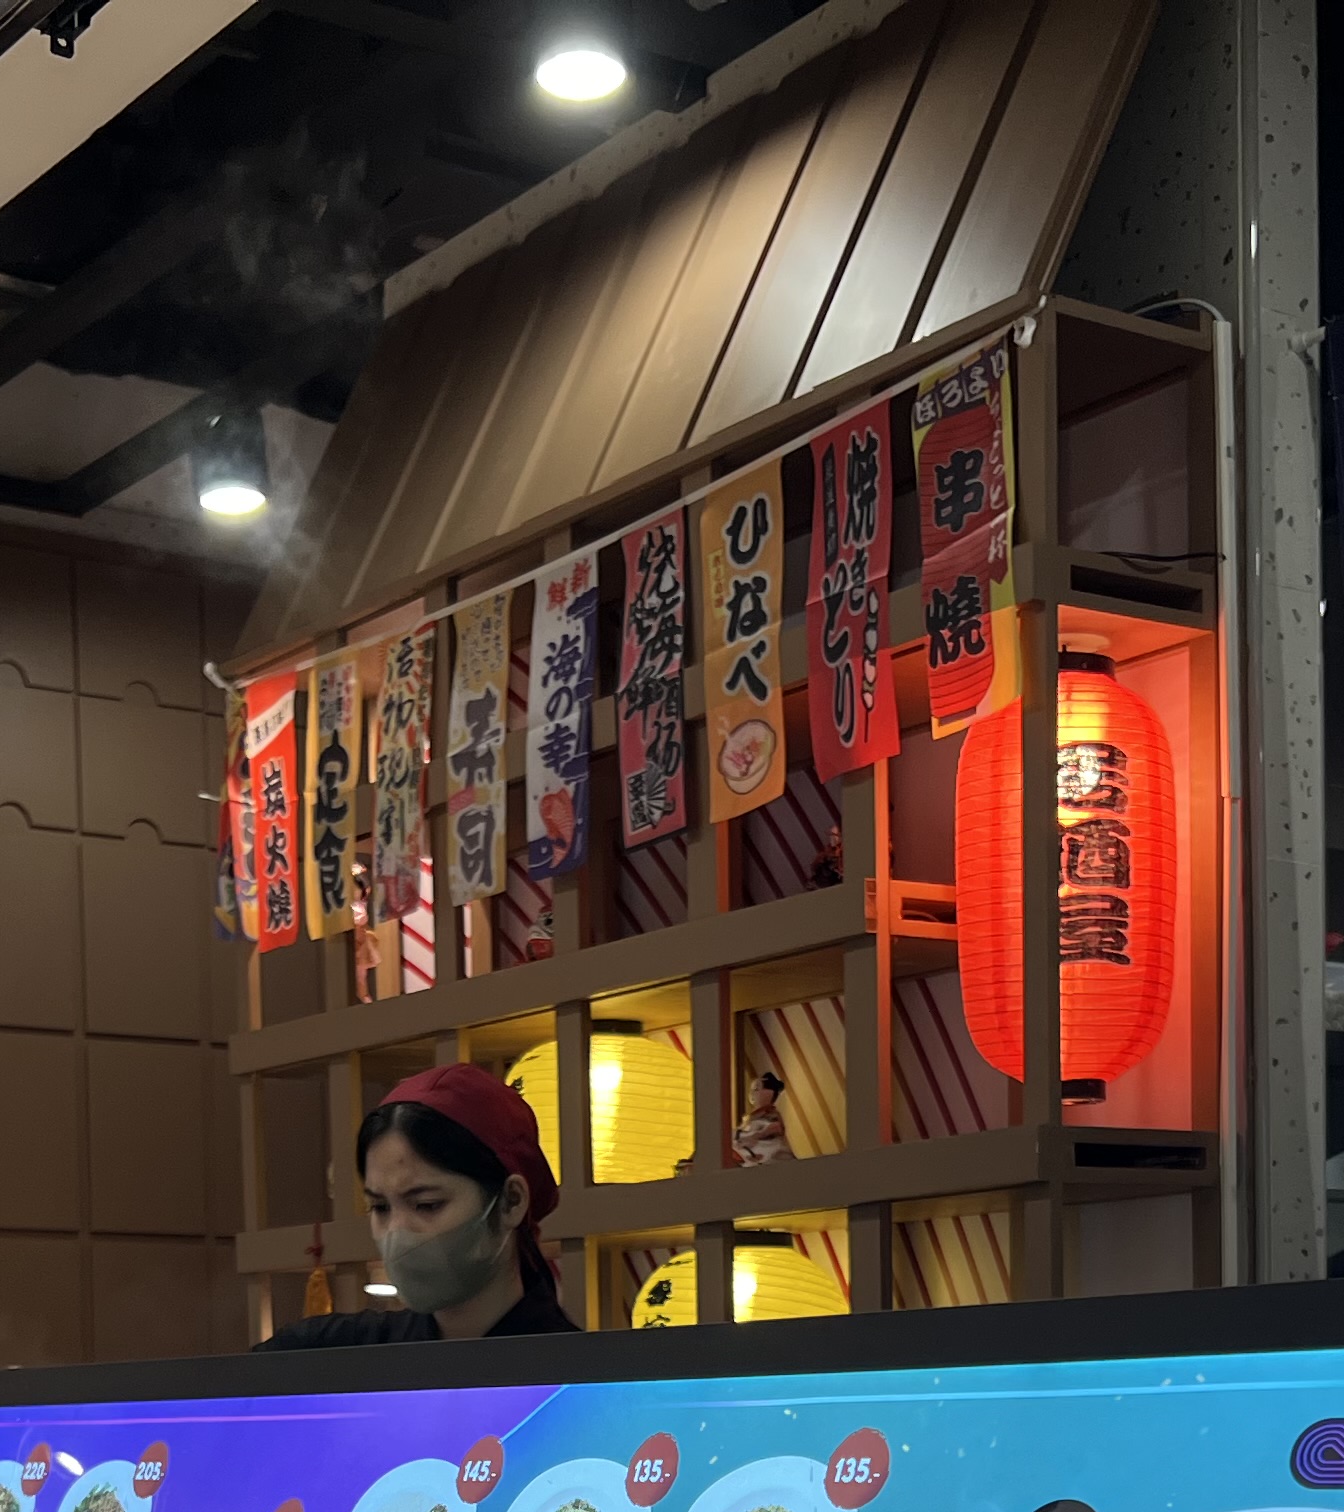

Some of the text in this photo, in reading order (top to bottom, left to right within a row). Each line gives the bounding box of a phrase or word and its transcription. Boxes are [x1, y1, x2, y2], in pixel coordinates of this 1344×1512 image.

[537, 633, 582, 772] 海の幸
[313, 727, 350, 914] 定食
[633, 1459, 671, 1483] 135.-
[834, 1457, 880, 1484] 135.-
